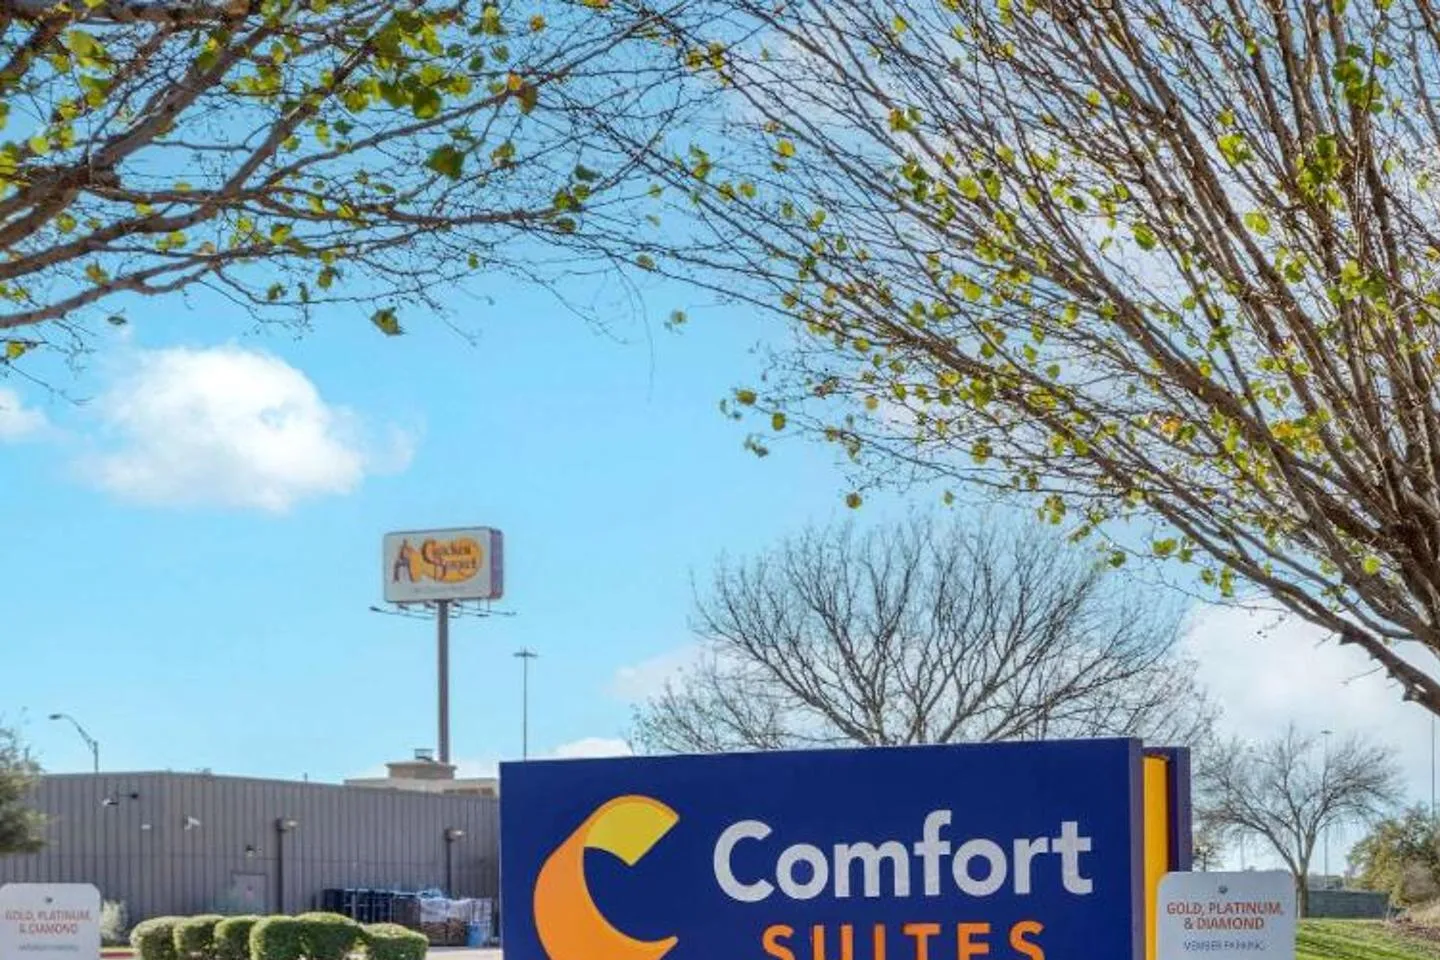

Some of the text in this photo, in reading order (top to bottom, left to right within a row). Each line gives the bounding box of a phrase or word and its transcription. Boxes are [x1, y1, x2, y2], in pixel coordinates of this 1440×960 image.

[713, 809, 1094, 902] Comfort
[1167, 901, 1285, 917] GOLD, PLATINUM,
[1183, 917, 1265, 931] & DIAMOND
